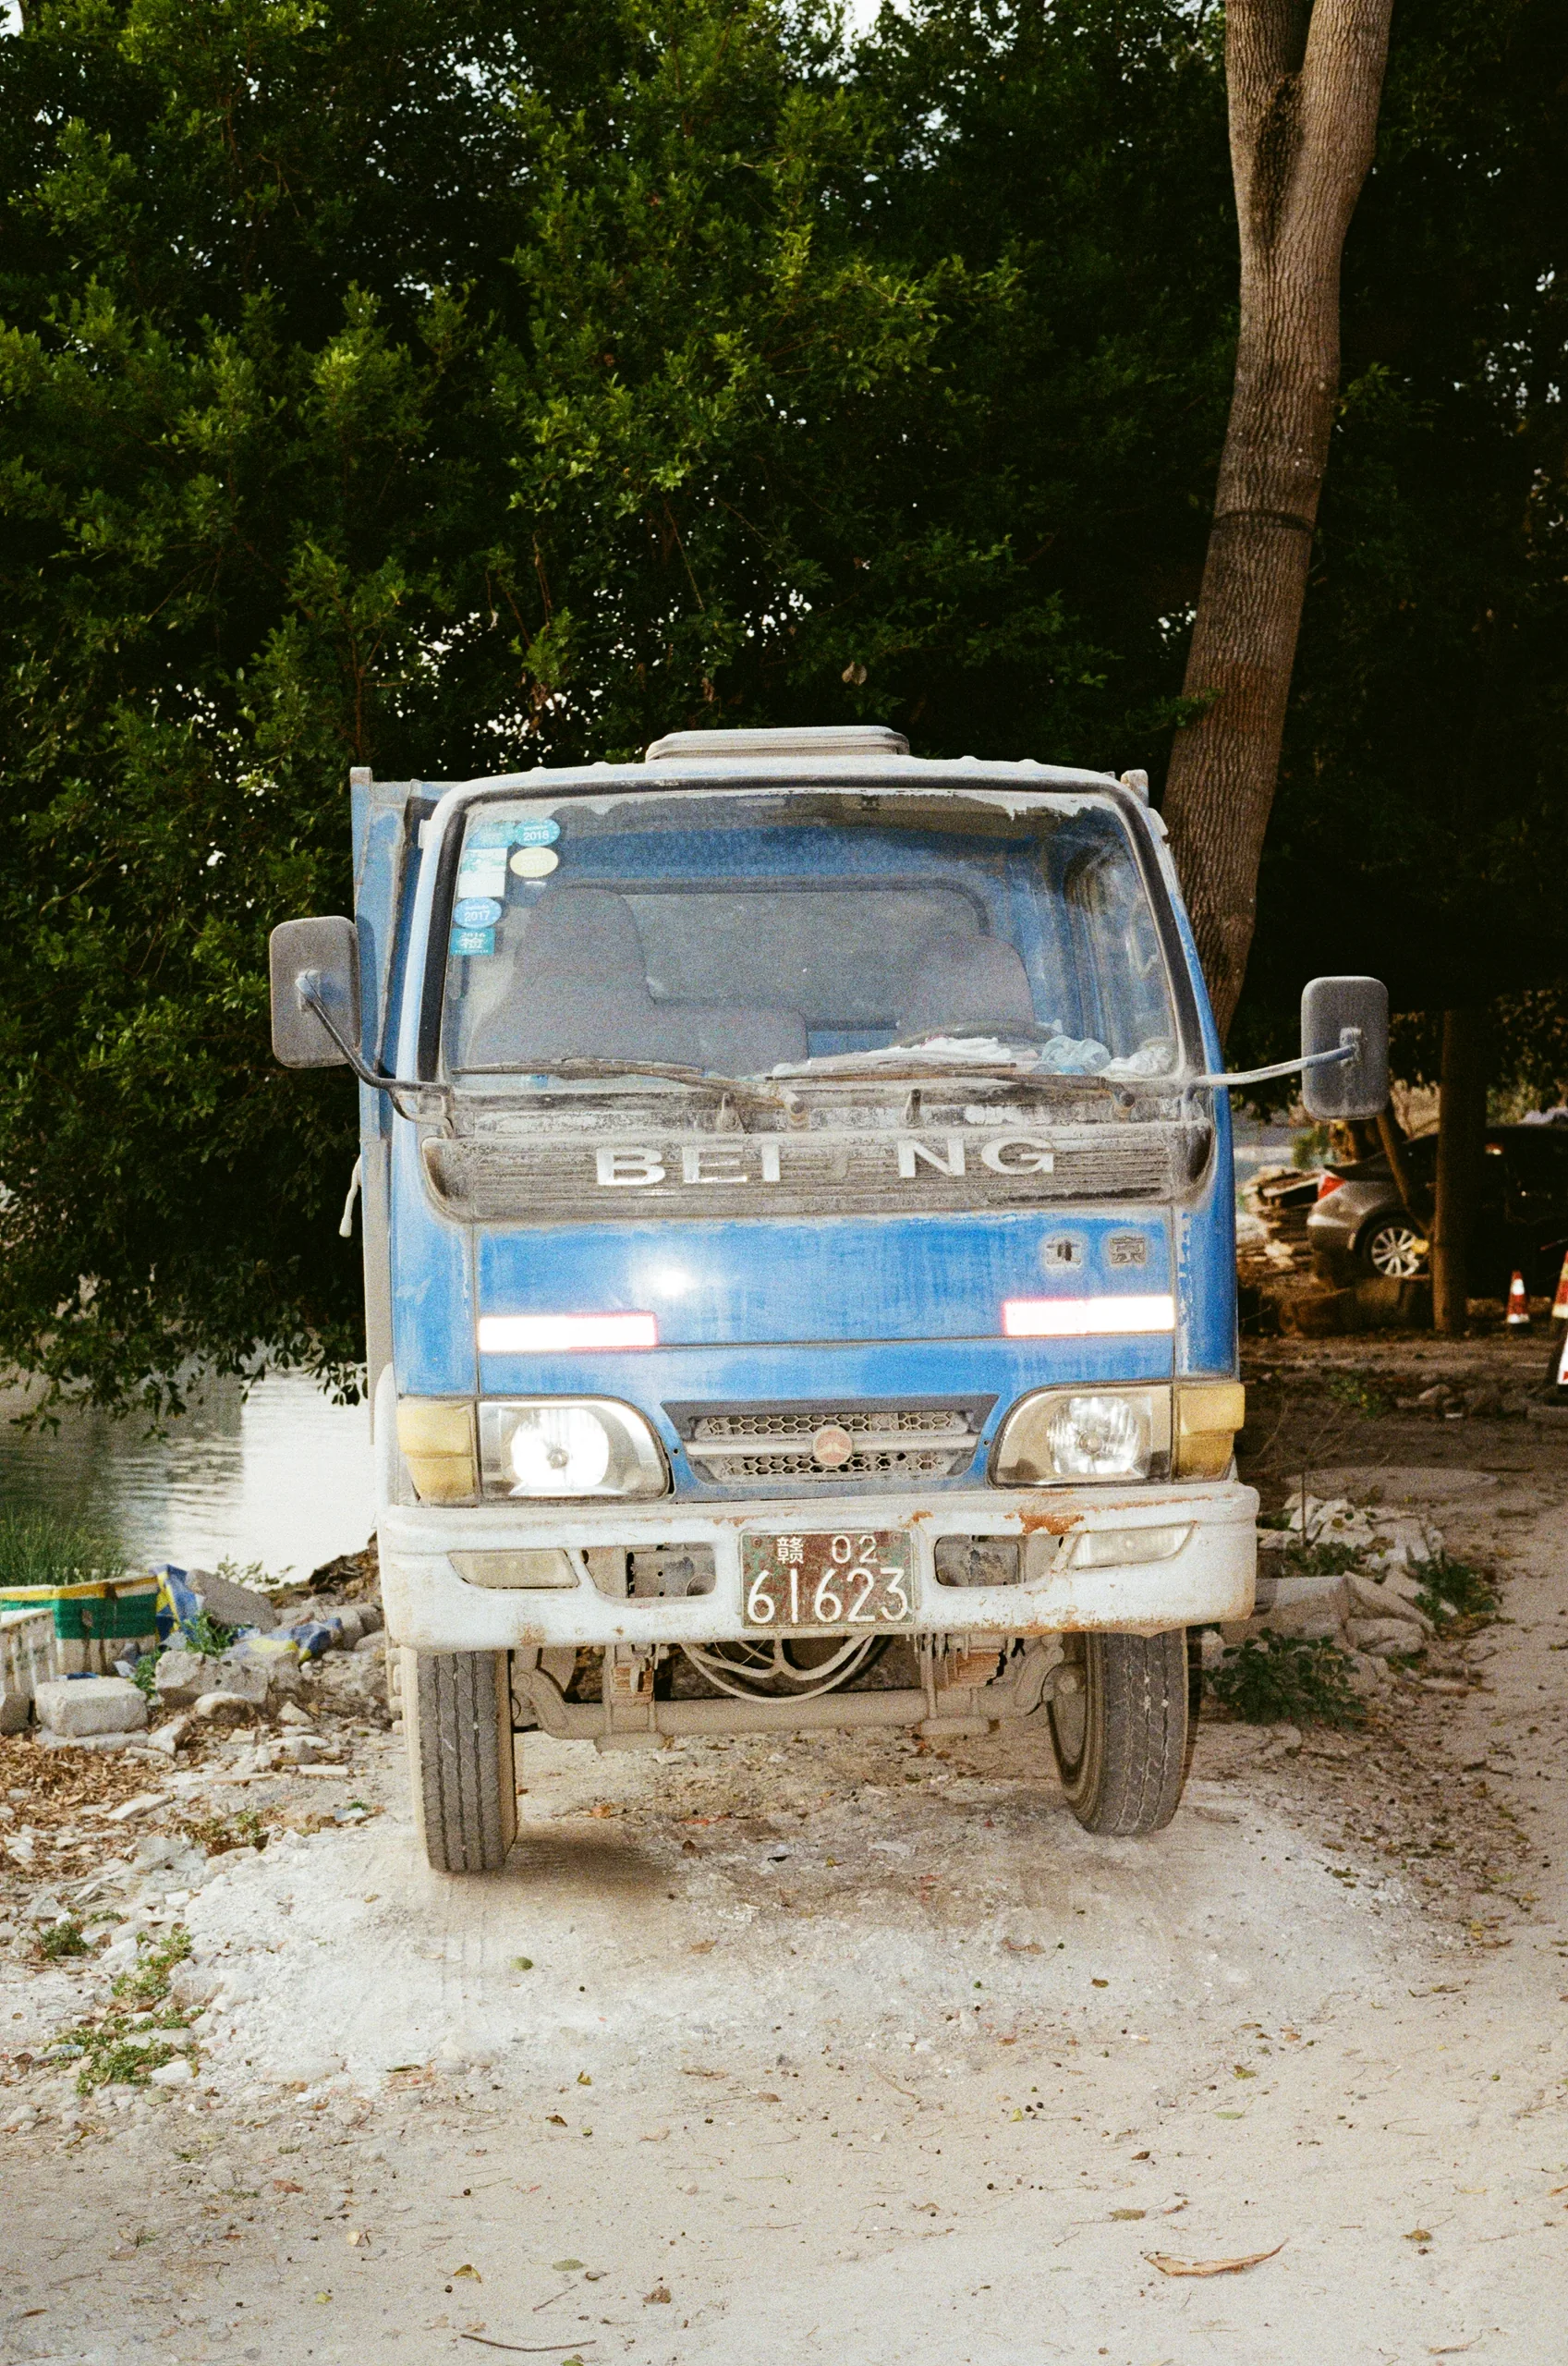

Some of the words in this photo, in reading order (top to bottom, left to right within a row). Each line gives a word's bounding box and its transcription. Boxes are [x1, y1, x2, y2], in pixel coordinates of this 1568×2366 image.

[464, 910, 491, 922] 2017
[776, 1536, 804, 1565] 赣
[831, 1534, 879, 1565] 02
[747, 1567, 909, 1624] 61623
